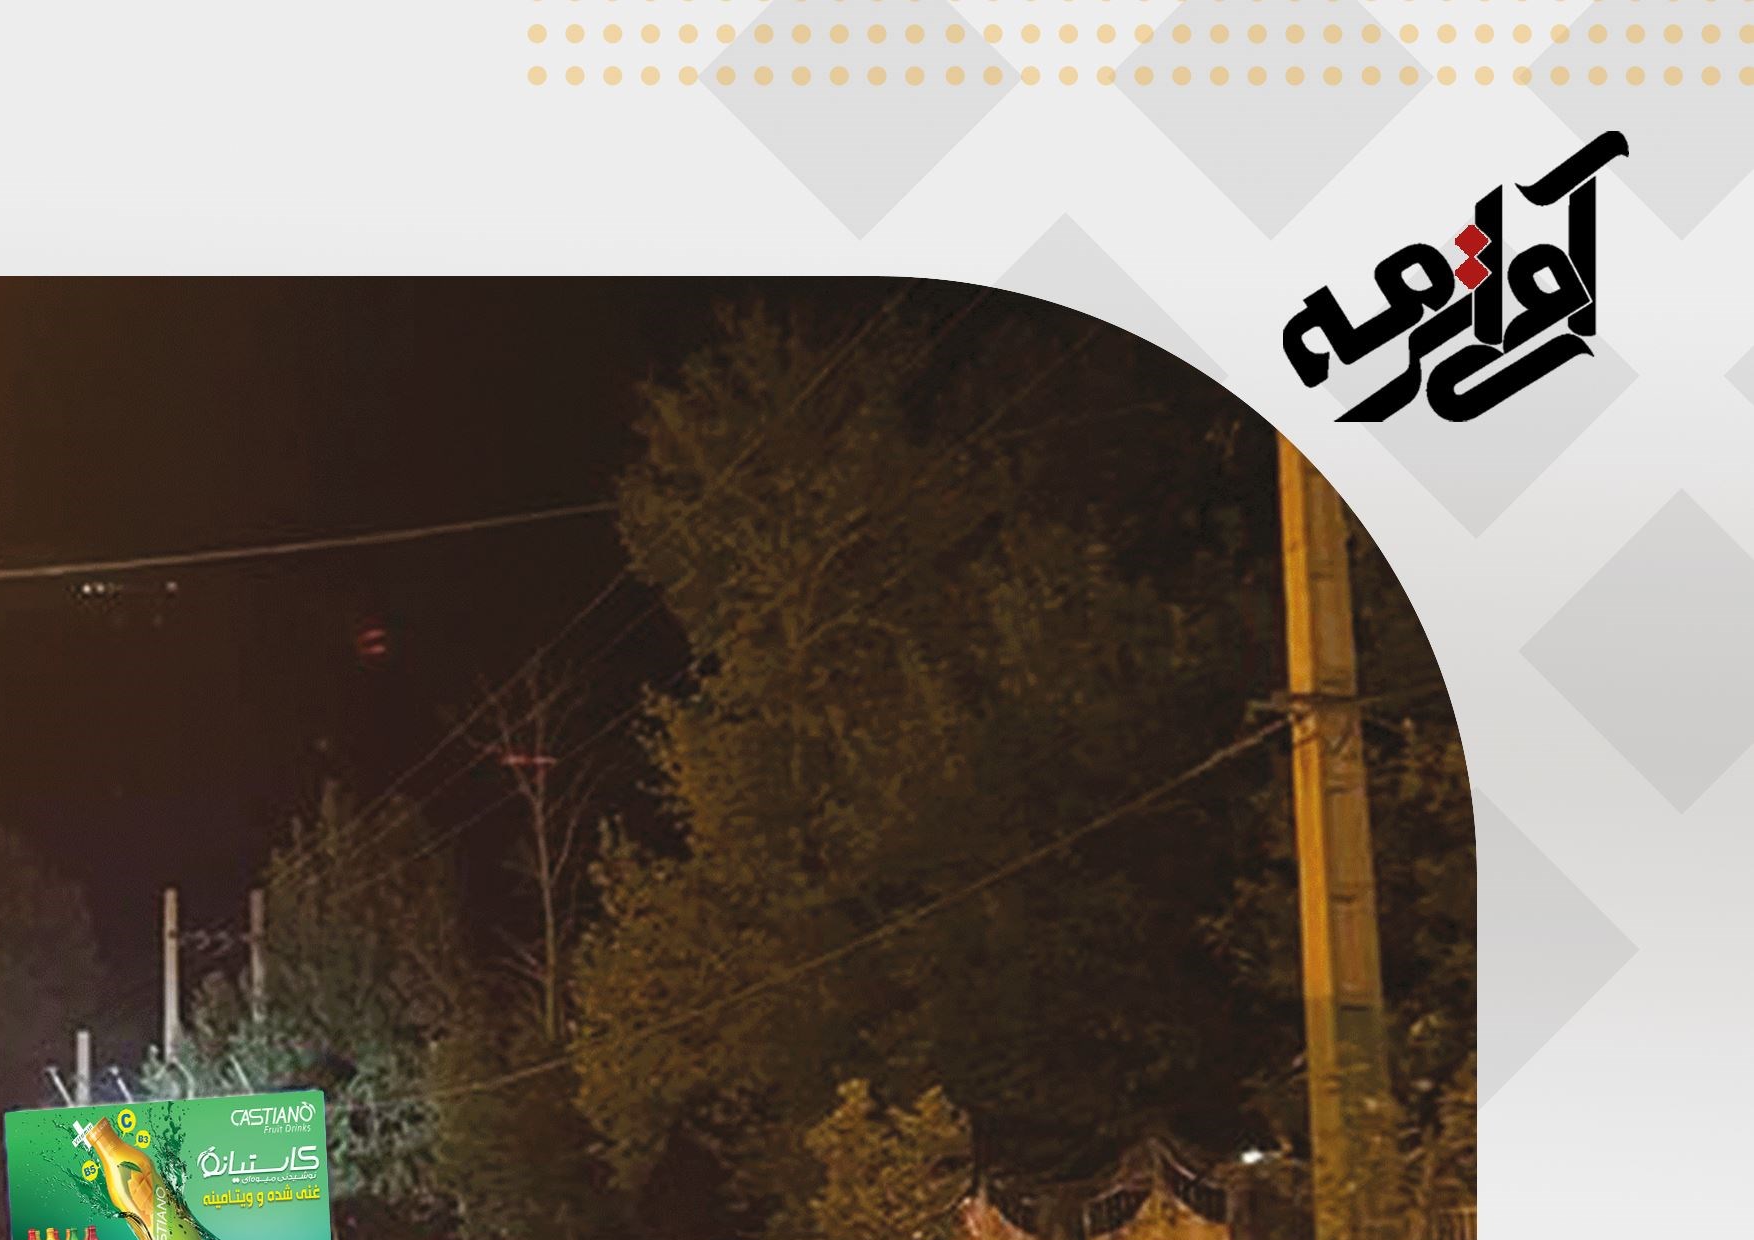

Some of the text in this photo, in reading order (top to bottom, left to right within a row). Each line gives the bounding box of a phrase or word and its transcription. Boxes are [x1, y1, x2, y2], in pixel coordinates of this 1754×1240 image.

[231, 1101, 316, 1126] CASTIANO
[121, 1113, 132, 1128] C
[264, 1124, 311, 1134] Fruit Drinks
[138, 1135, 149, 1143] B3
[83, 1165, 96, 1176] B5
[203, 1184, 320, 1208] غنی شده و ویتامینه
